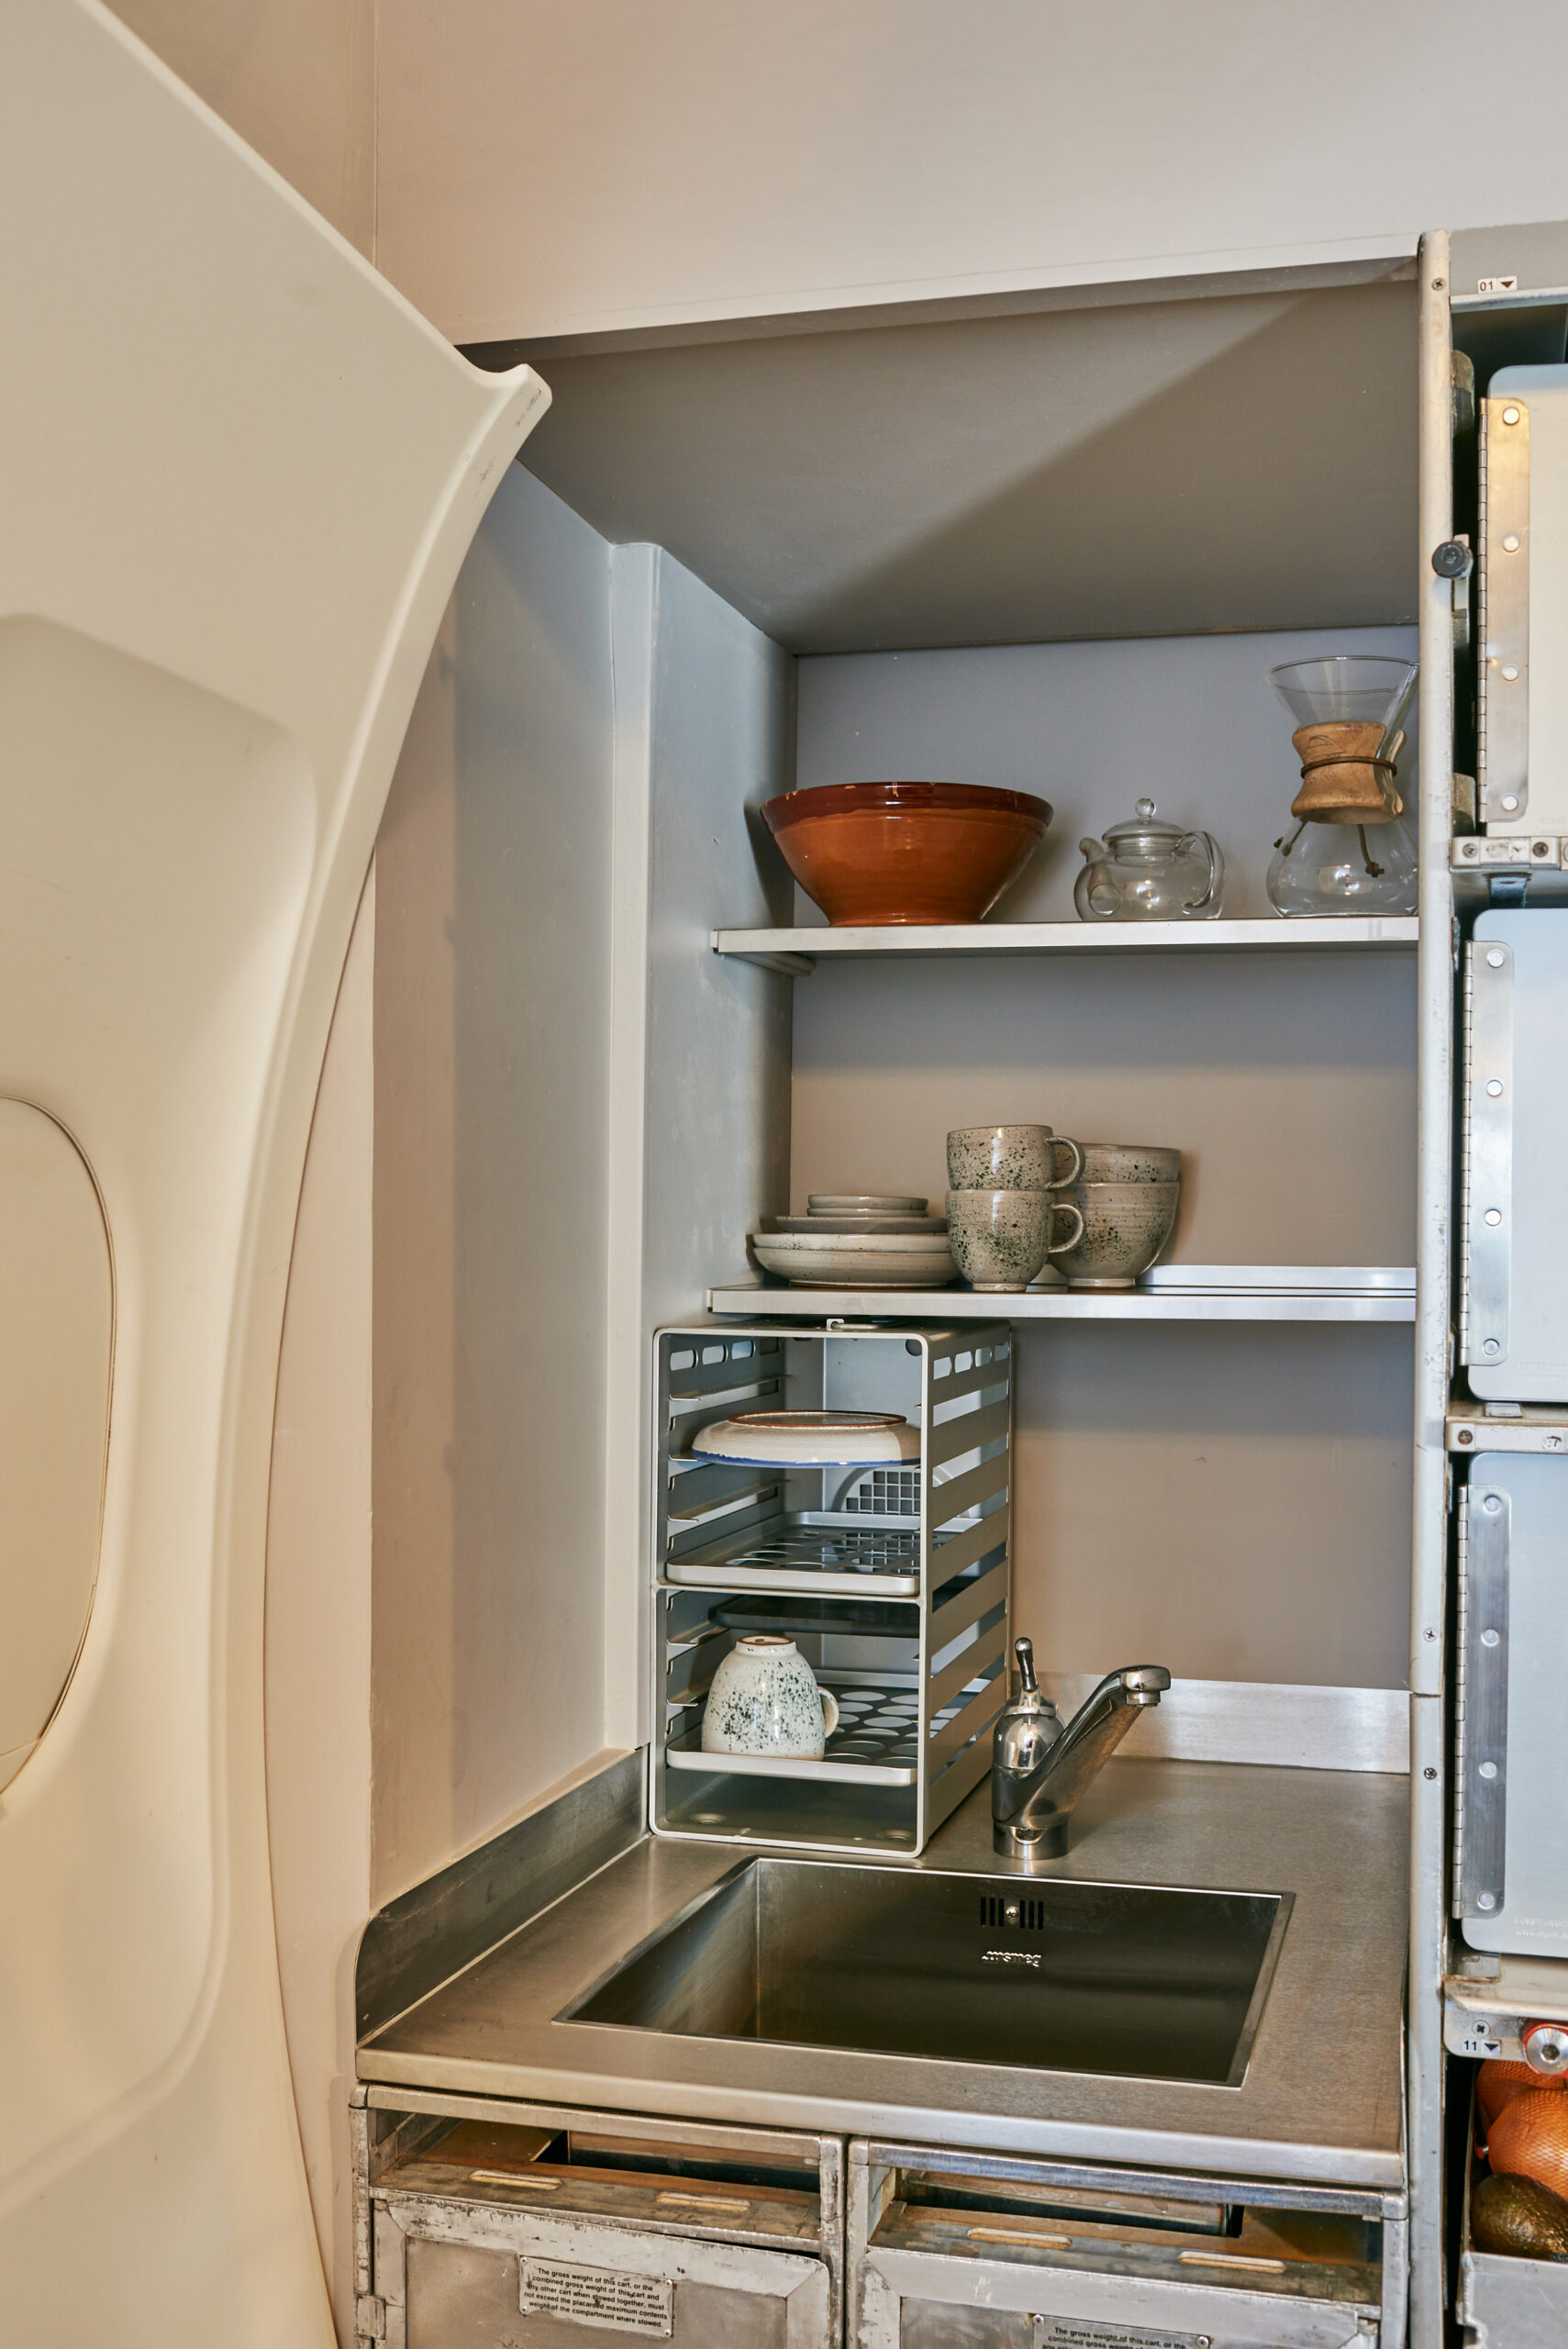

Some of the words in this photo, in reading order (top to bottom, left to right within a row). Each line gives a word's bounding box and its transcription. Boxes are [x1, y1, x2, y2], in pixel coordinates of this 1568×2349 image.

[1480, 281, 1492, 292] 01
[1463, 2040, 1476, 2051] 11
[539, 2267, 550, 2276] The
[604, 2277, 616, 2286] this
[532, 2276, 563, 2286] combined
[585, 2285, 606, 2293] weight
[529, 2301, 550, 2310] weight
[573, 2308, 615, 2320] compartment
[617, 2315, 636, 2323] where
[536, 2294, 559, 2302] exceed
[573, 2299, 604, 2310] placarded
[606, 2305, 638, 2315] maximum
[639, 2310, 668, 2320] contents
[1048, 2335, 1084, 2345] combined
[1086, 2341, 1106, 2349] gross
[1094, 2333, 1118, 2342] weight
